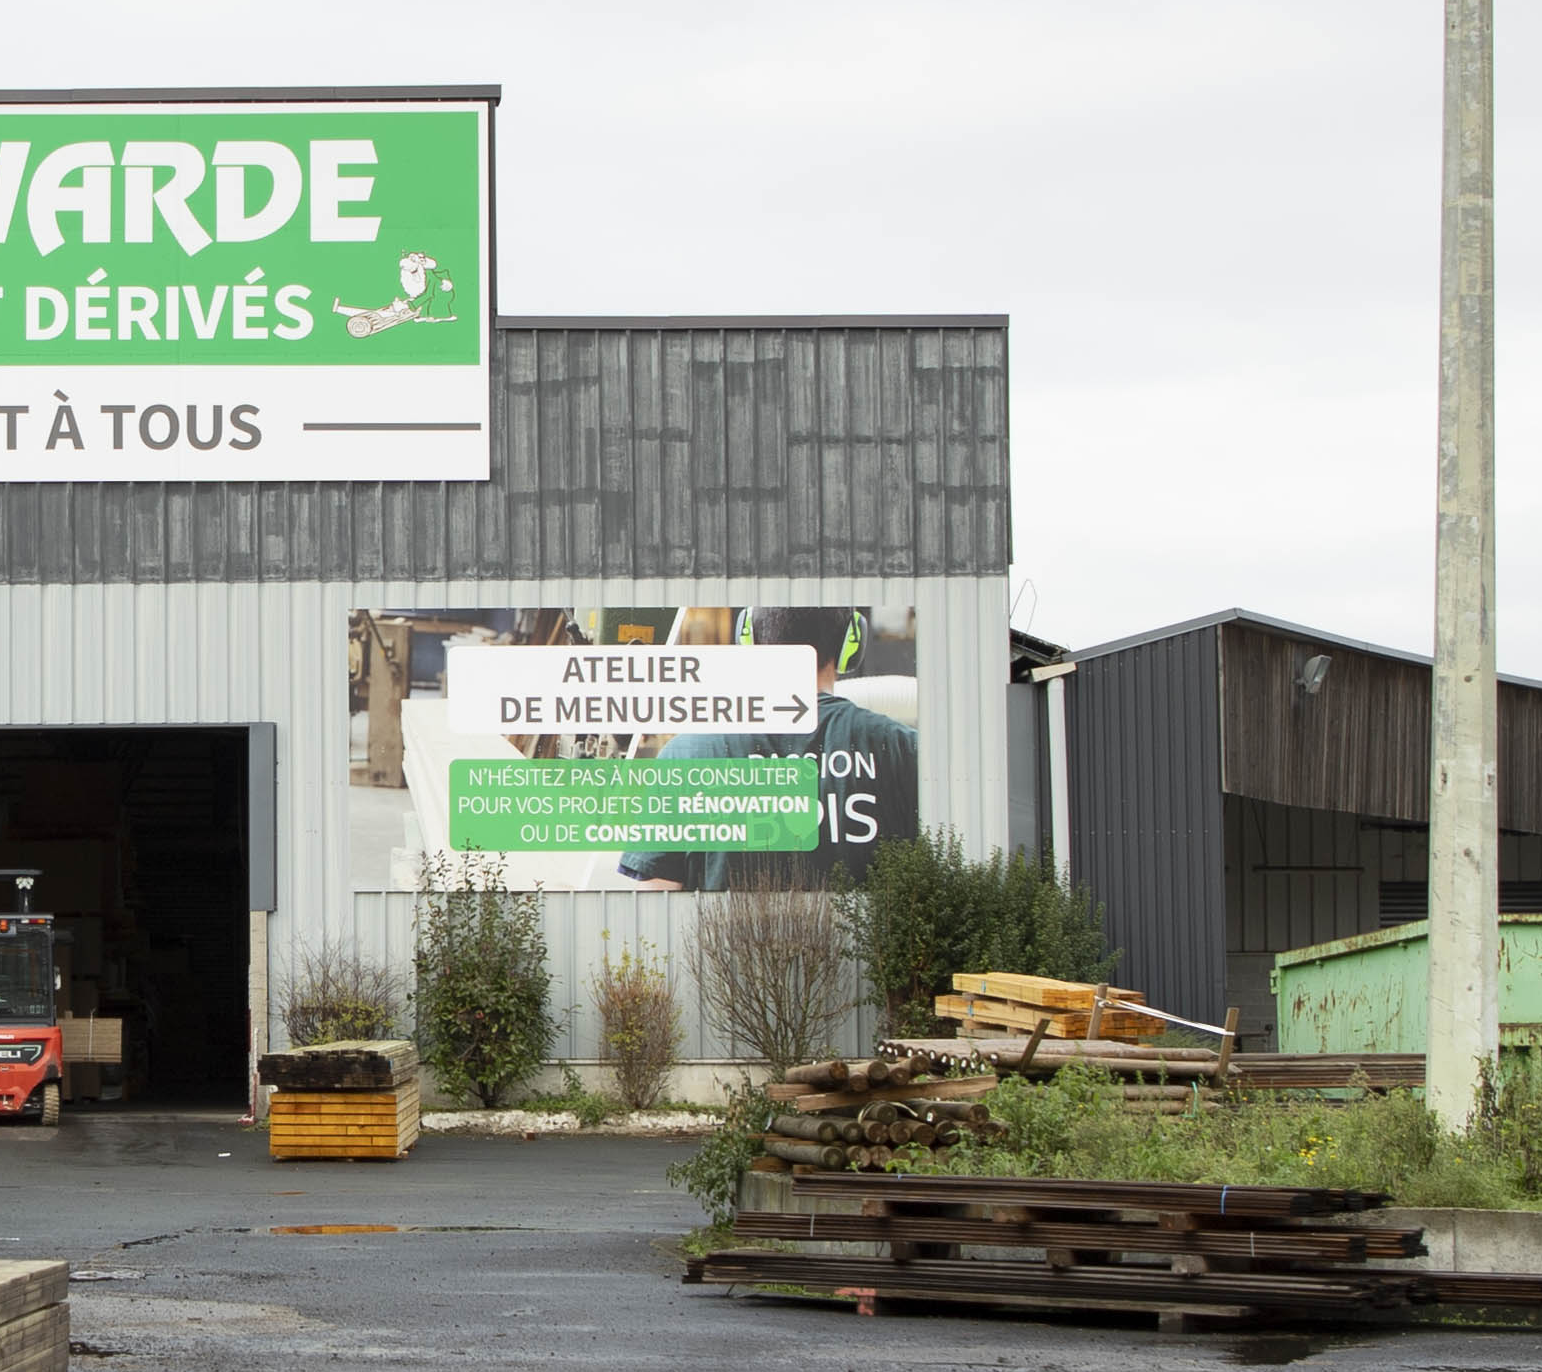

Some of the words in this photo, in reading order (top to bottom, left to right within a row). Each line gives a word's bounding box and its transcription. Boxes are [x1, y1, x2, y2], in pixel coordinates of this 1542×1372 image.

[25, 266, 314, 342] DÉRIVÉS
[45, 388, 84, 451] À
[100, 403, 262, 451] TOUS
[562, 656, 701, 683] ATELIER
[500, 696, 543, 723] DE
[555, 695, 765, 723] MENUISERIE
[469, 765, 564, 787] N'HÉSITEZ
[571, 768, 605, 786] PAS
[610, 762, 624, 786] À
[628, 768, 684, 786] NOUS
[688, 767, 799, 787] CONSULTER
[459, 796, 512, 815] POUR
[516, 796, 554, 815] VOS
[558, 796, 643, 815] PROJETS
[648, 796, 673, 814] DE
[678, 791, 810, 814] RÉNOVATION
[520, 824, 550, 843] OU
[555, 824, 580, 843] DE
[584, 823, 747, 843] CONSTRUCTION
